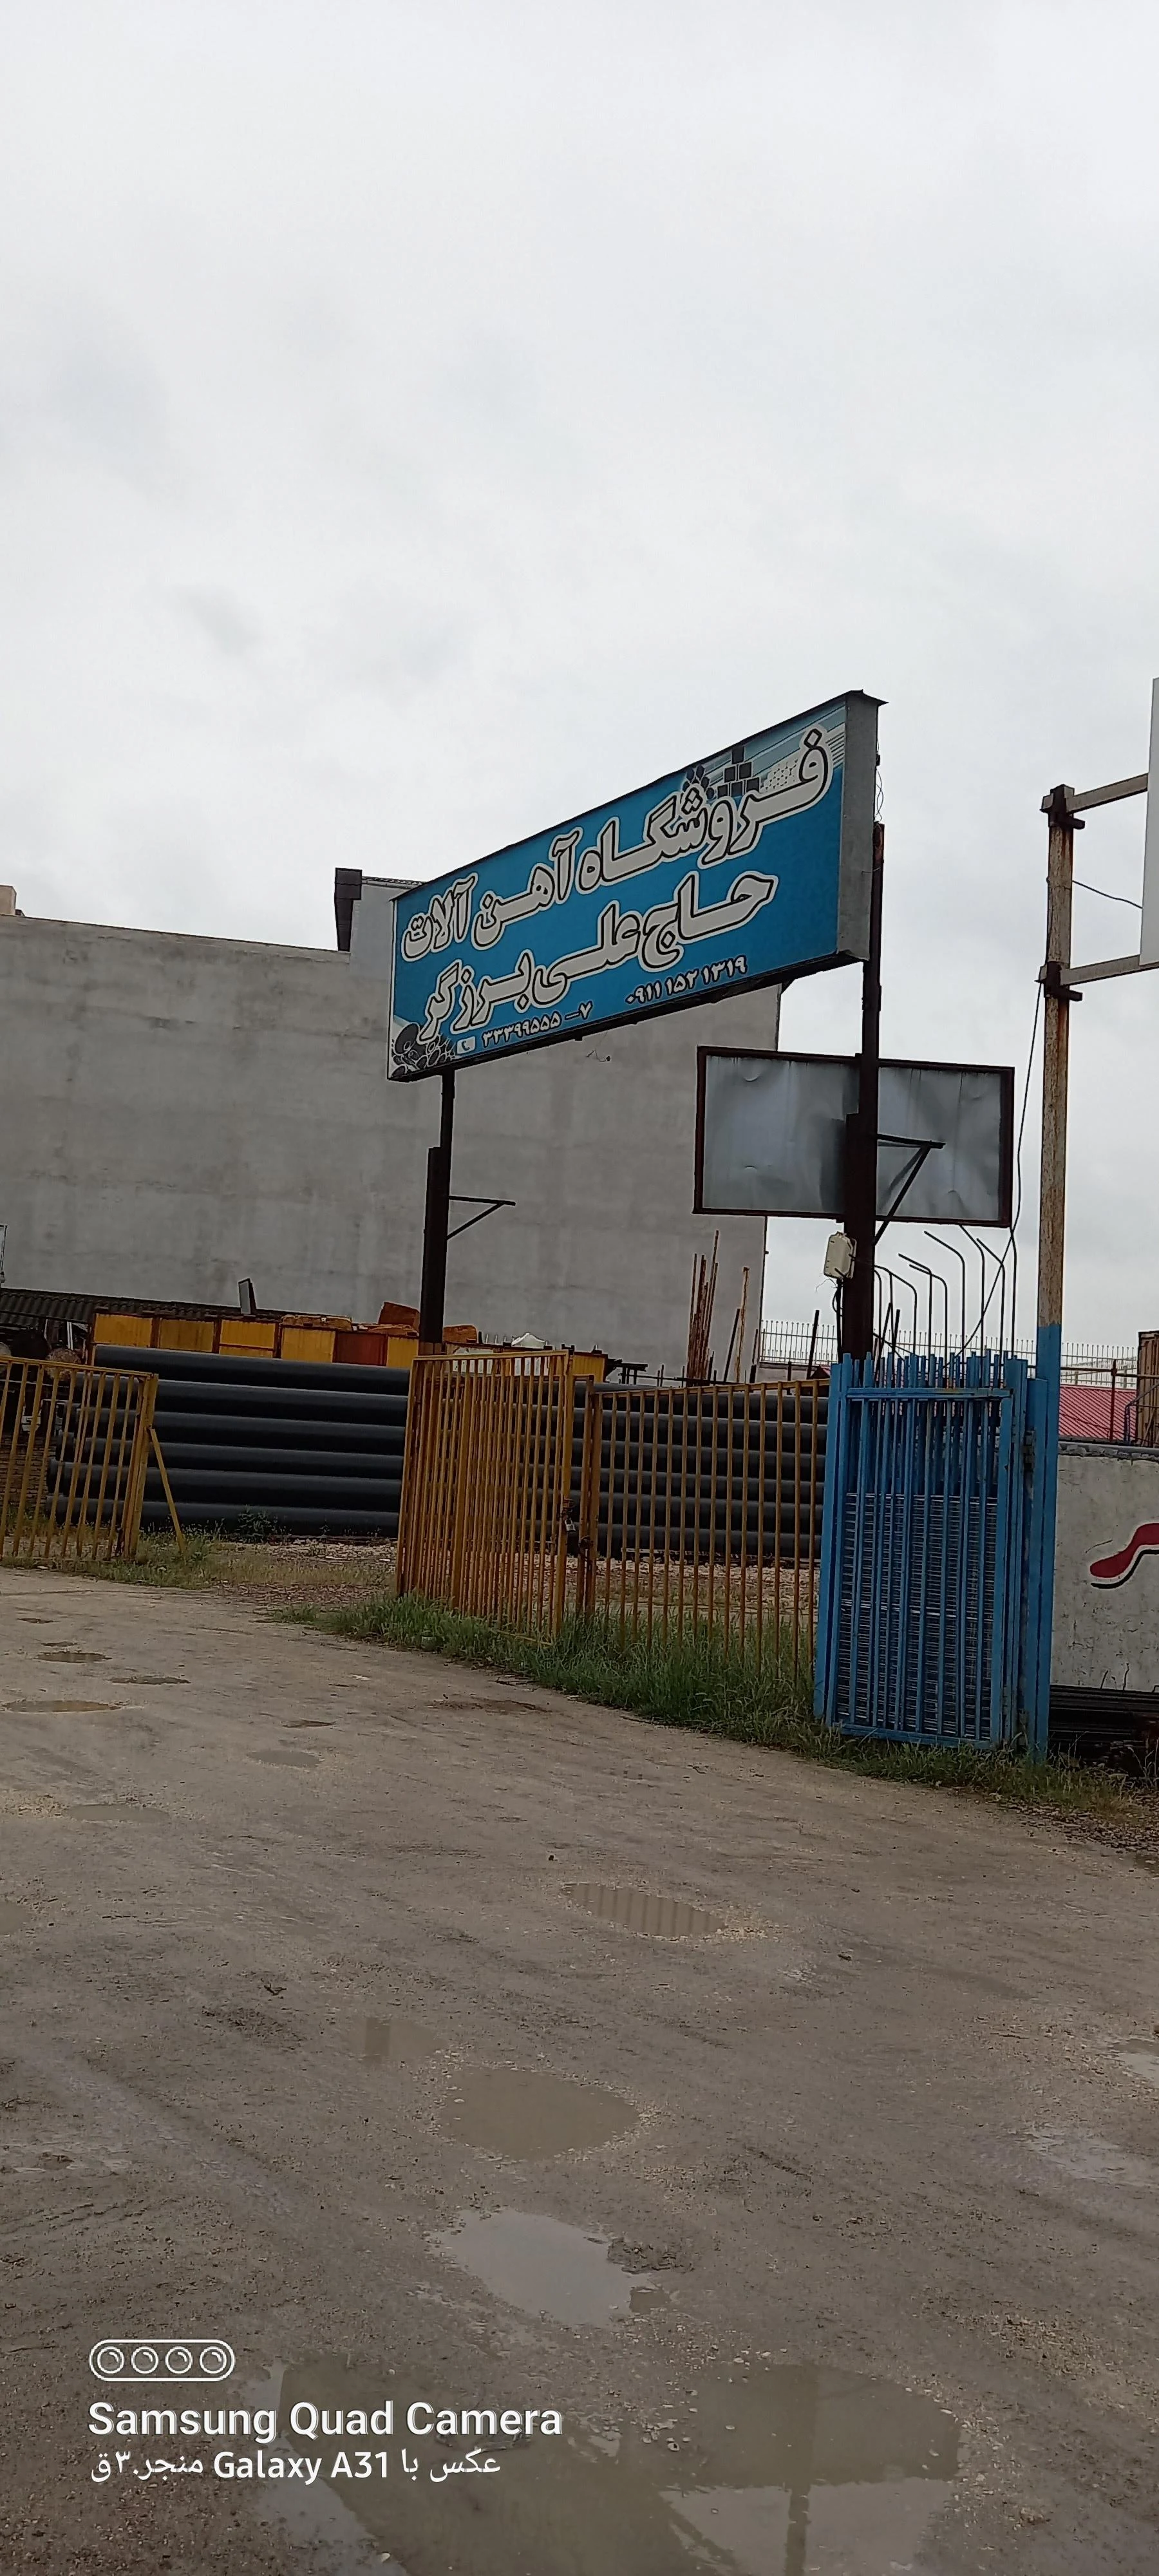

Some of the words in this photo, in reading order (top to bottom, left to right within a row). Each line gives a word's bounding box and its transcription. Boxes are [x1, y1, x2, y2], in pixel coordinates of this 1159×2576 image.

[578, 728, 829, 893] فروشگاه
[402, 873, 478, 960] آلات
[473, 829, 581, 949] آهن
[642, 871, 777, 970] حاج
[419, 950, 534, 1043] برزگر
[532, 901, 641, 1007] علی
